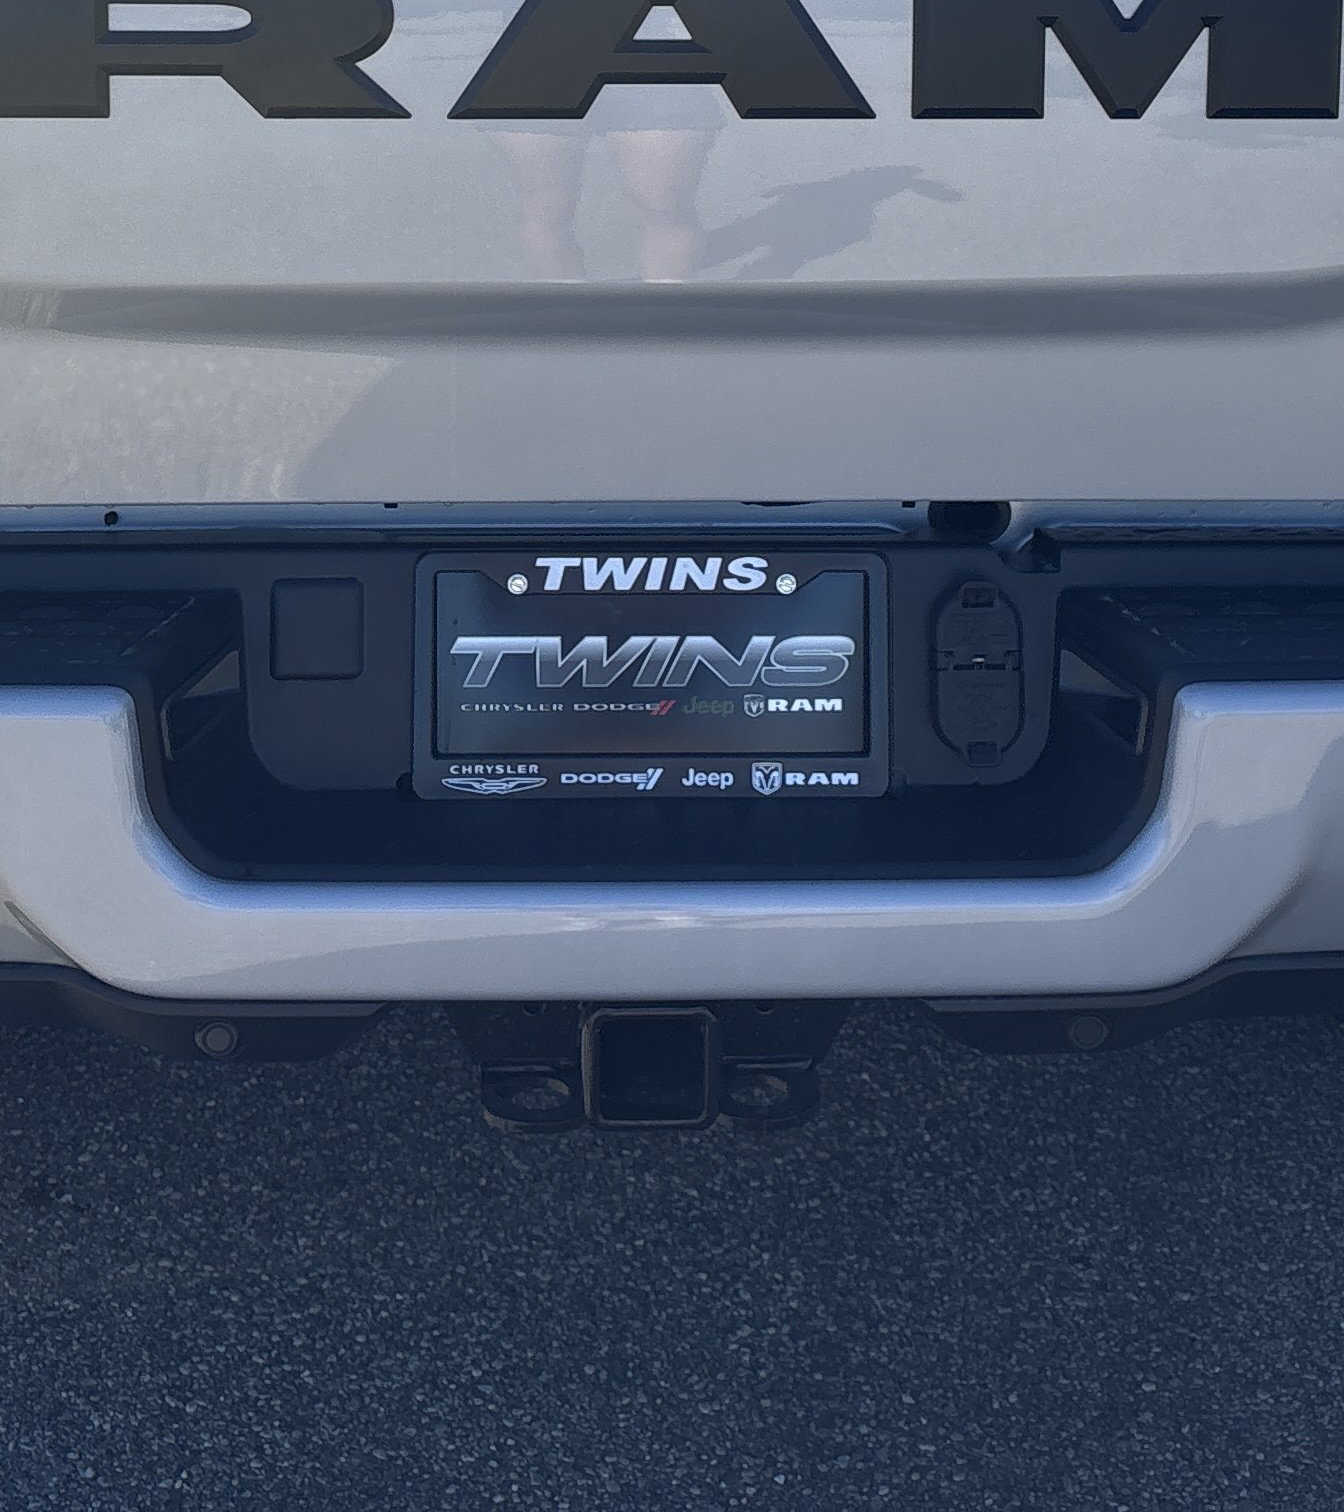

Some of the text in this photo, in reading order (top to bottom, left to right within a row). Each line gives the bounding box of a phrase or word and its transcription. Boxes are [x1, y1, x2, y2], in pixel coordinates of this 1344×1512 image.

[535, 556, 769, 591] TWINS
[449, 635, 856, 688] TWINS
[460, 695, 843, 716] CHRYSLER DODGE Jeep RAM
[449, 764, 860, 788] CHRYSLER DODGE Jeep RAM
